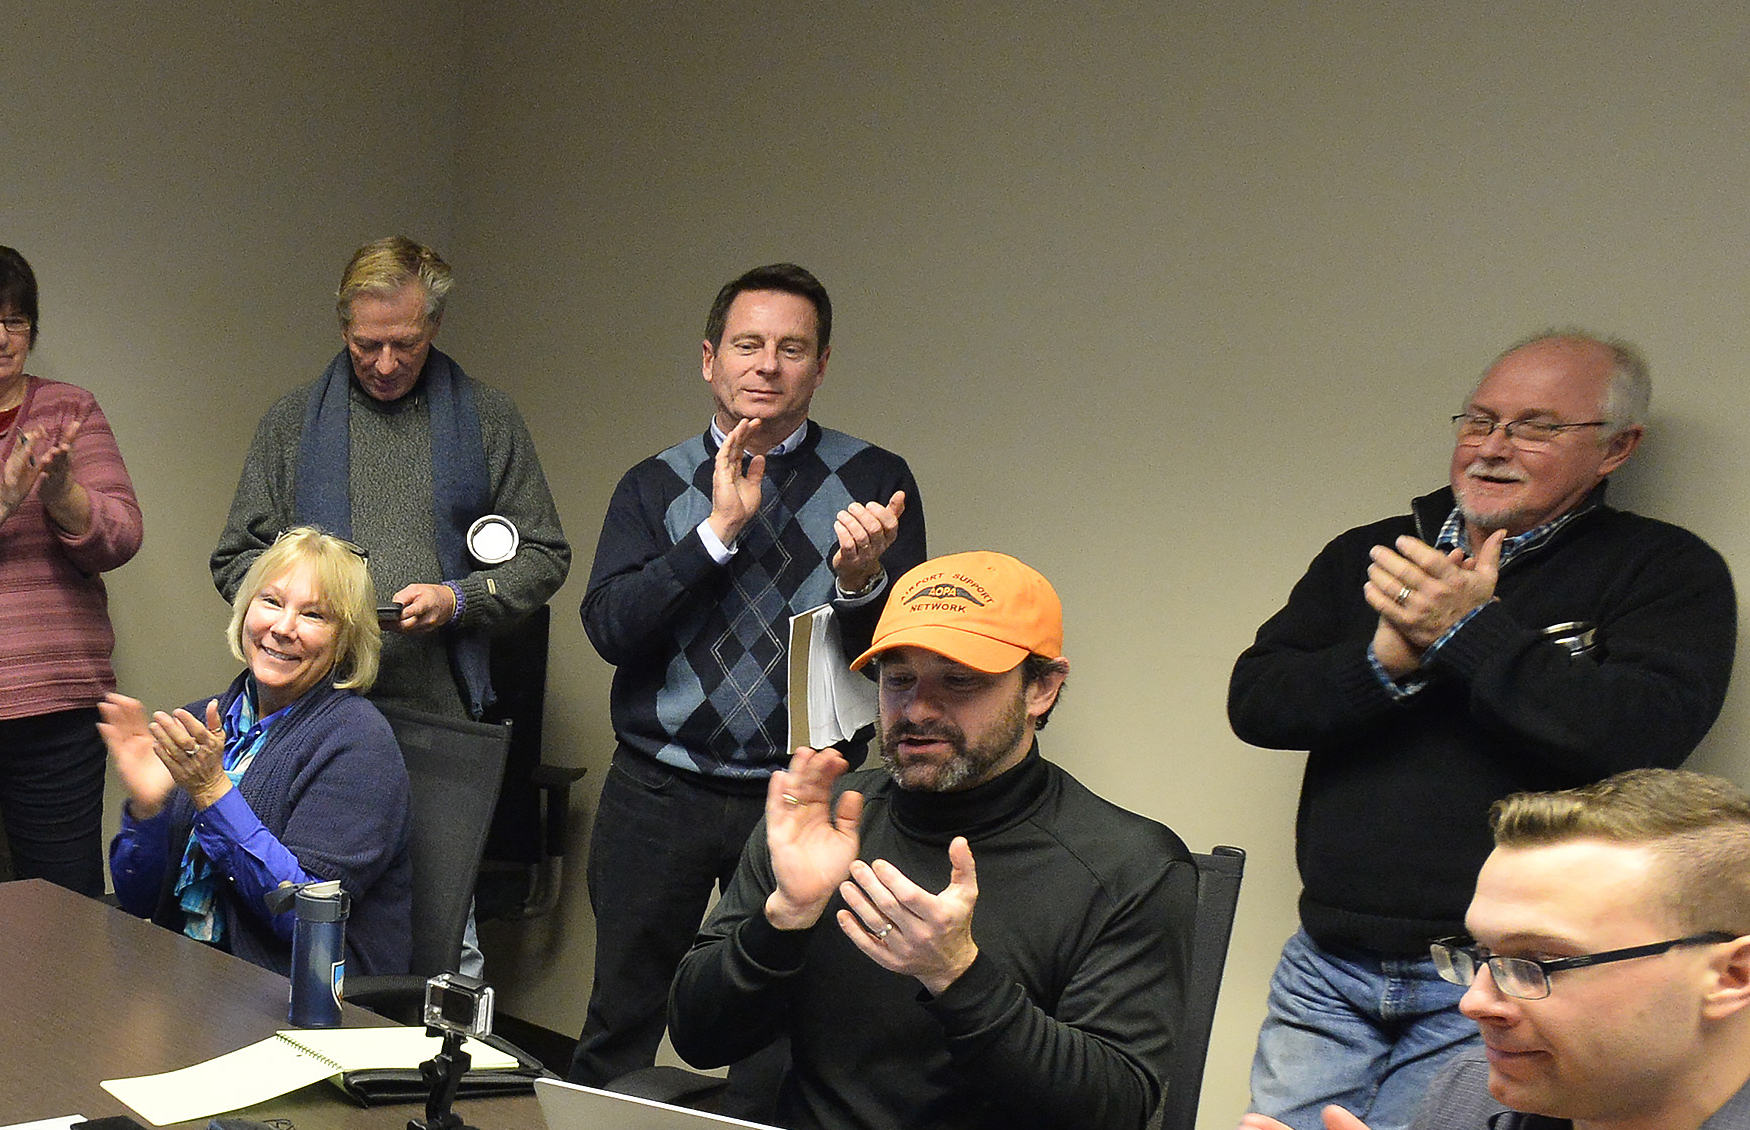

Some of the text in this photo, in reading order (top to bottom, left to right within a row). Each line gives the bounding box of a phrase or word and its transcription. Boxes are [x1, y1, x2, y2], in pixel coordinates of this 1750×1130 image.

[901, 573, 995, 603] AIRPORT SUPPORT
[928, 586, 957, 597] AOPA
[909, 602, 967, 613] NETWORK
